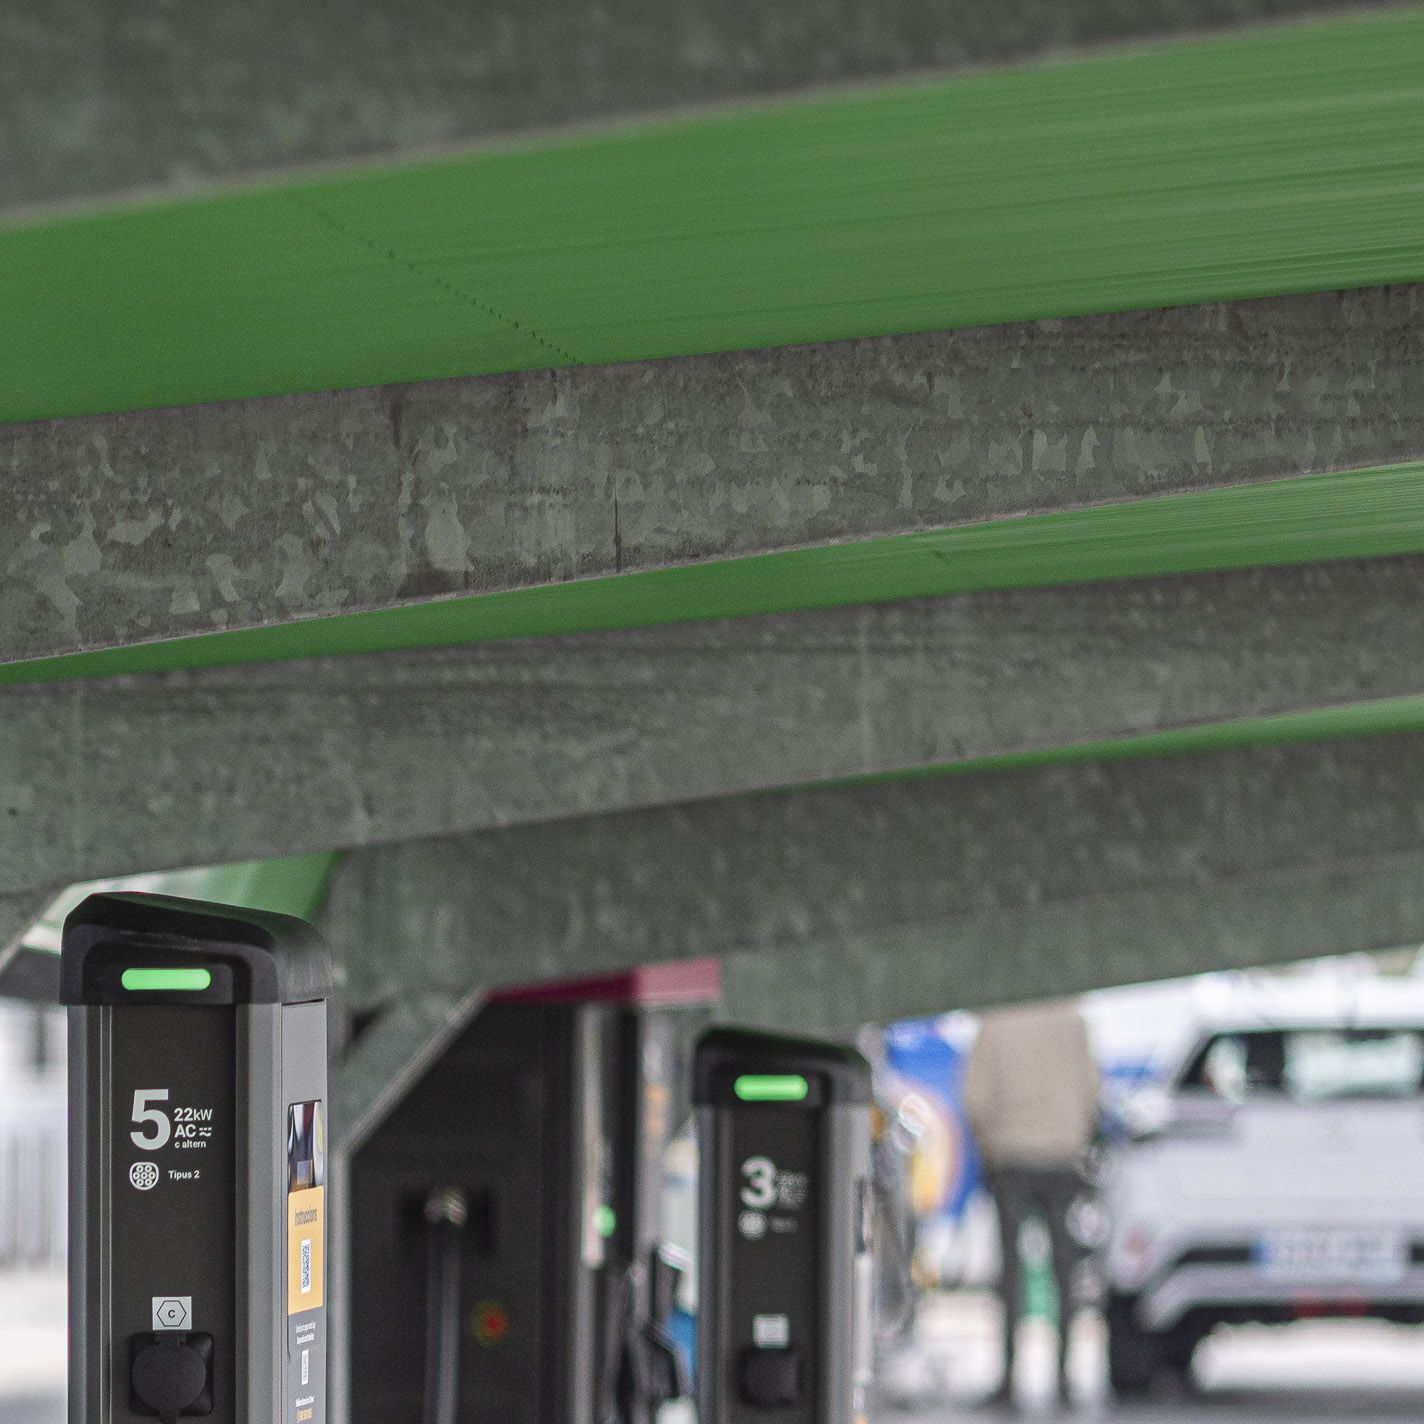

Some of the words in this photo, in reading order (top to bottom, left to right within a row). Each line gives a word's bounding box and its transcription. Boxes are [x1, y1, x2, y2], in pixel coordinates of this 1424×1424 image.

[130, 1088, 171, 1150] 5
[173, 1107, 213, 1122] 22kW
[174, 1124, 196, 1138] AC
[182, 1140, 206, 1148] altern
[168, 1170, 192, 1180] Tipus
[193, 1169, 200, 1179] 2
[740, 1156, 777, 1210] 3
